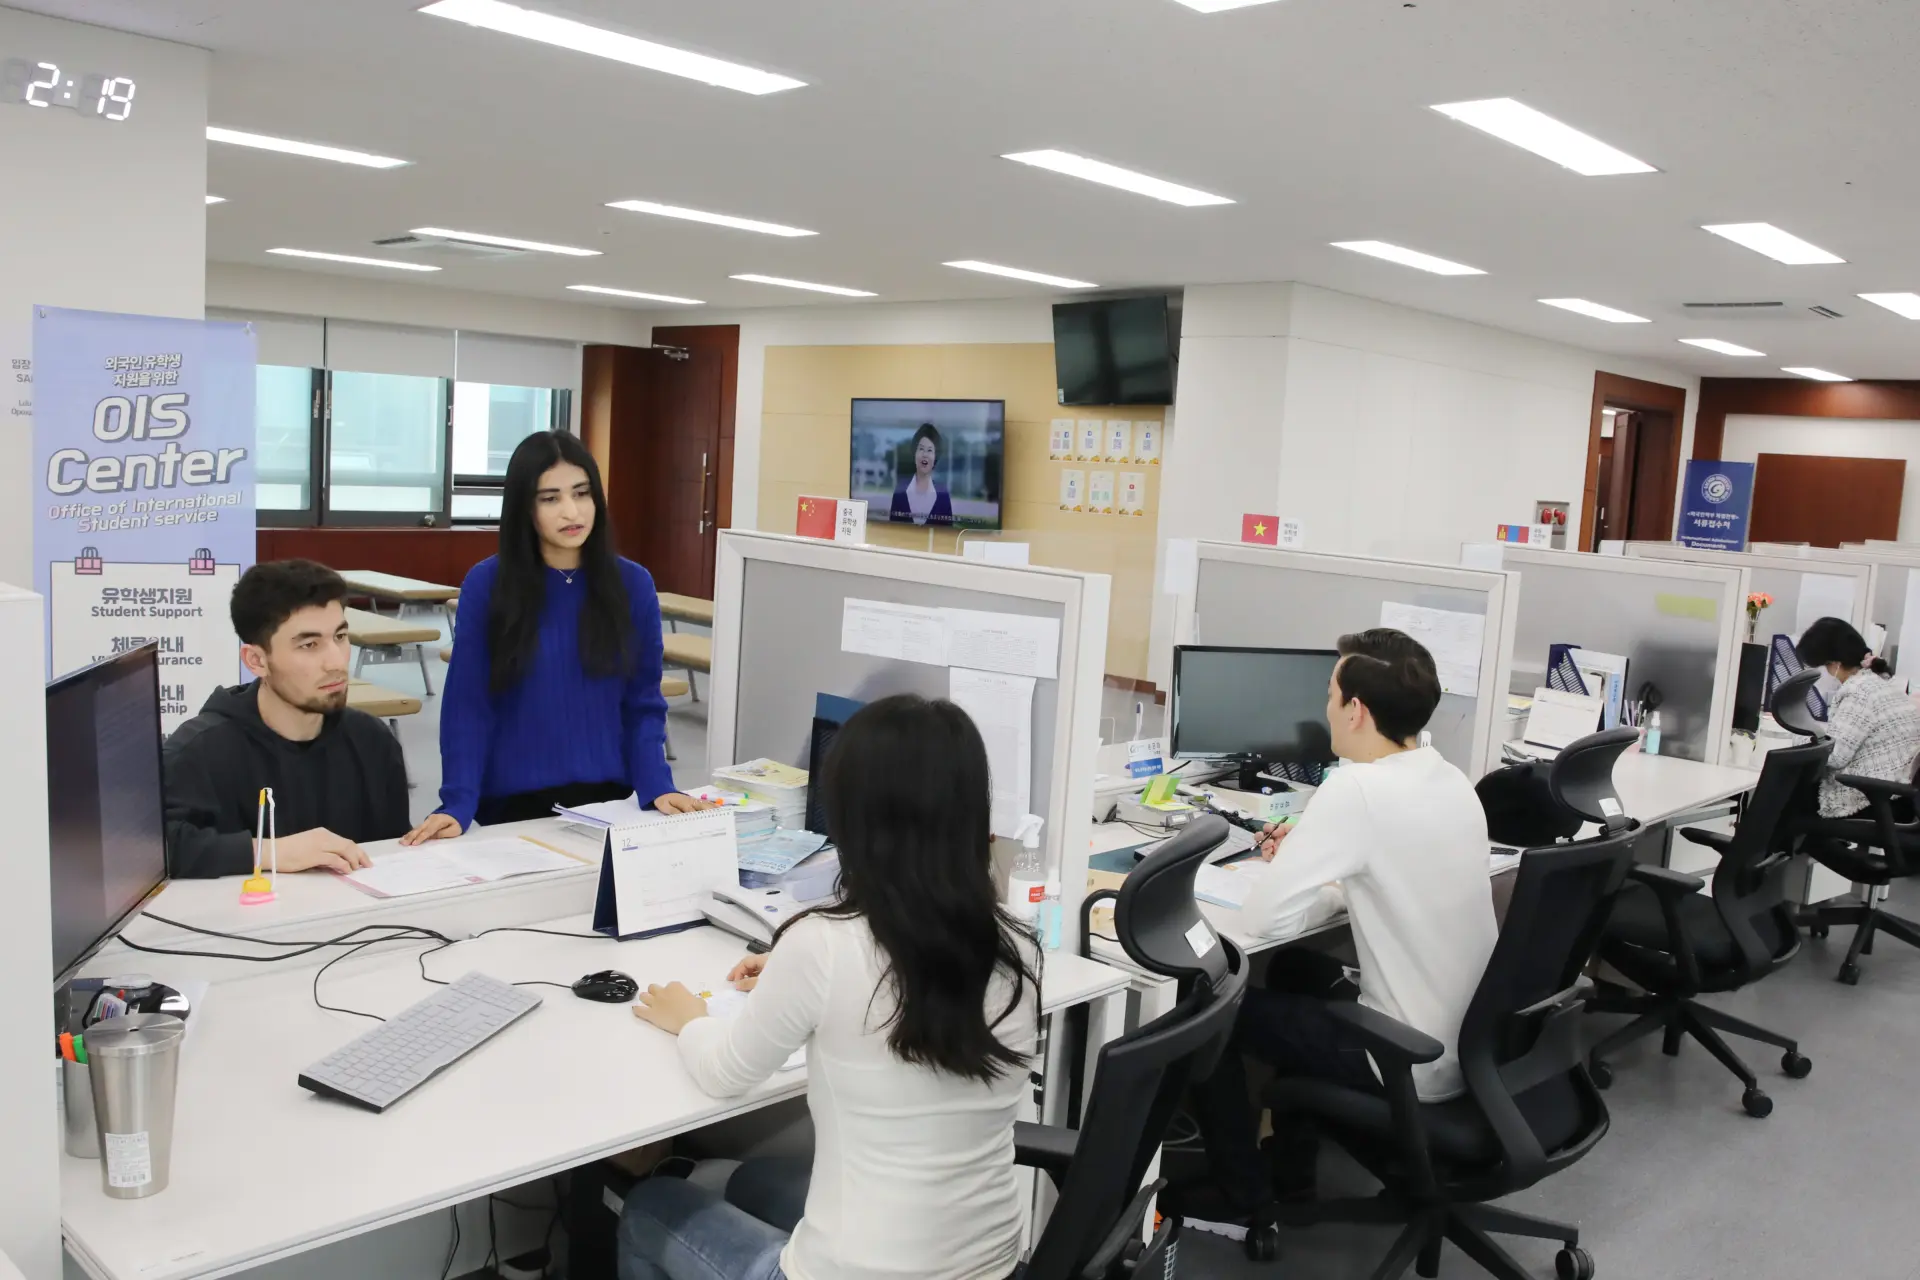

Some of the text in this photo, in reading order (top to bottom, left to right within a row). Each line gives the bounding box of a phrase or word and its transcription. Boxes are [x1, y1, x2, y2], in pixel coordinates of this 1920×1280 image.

[26, 62, 136, 121] 2:19
[104, 353, 183, 372] 외국인 유학생
[16, 373, 33, 384] SA
[113, 370, 179, 388] 지원을 위한
[92, 392, 191, 443] OIS
[46, 442, 247, 496] Center
[48, 491, 242, 520] Office of International
[77, 508, 218, 533] Student service
[842, 517, 857, 527] 유학생
[101, 587, 193, 605] 유학생지원
[91, 606, 203, 619] Student Support
[157, 656, 203, 665] urance
[622, 838, 632, 848] 12
